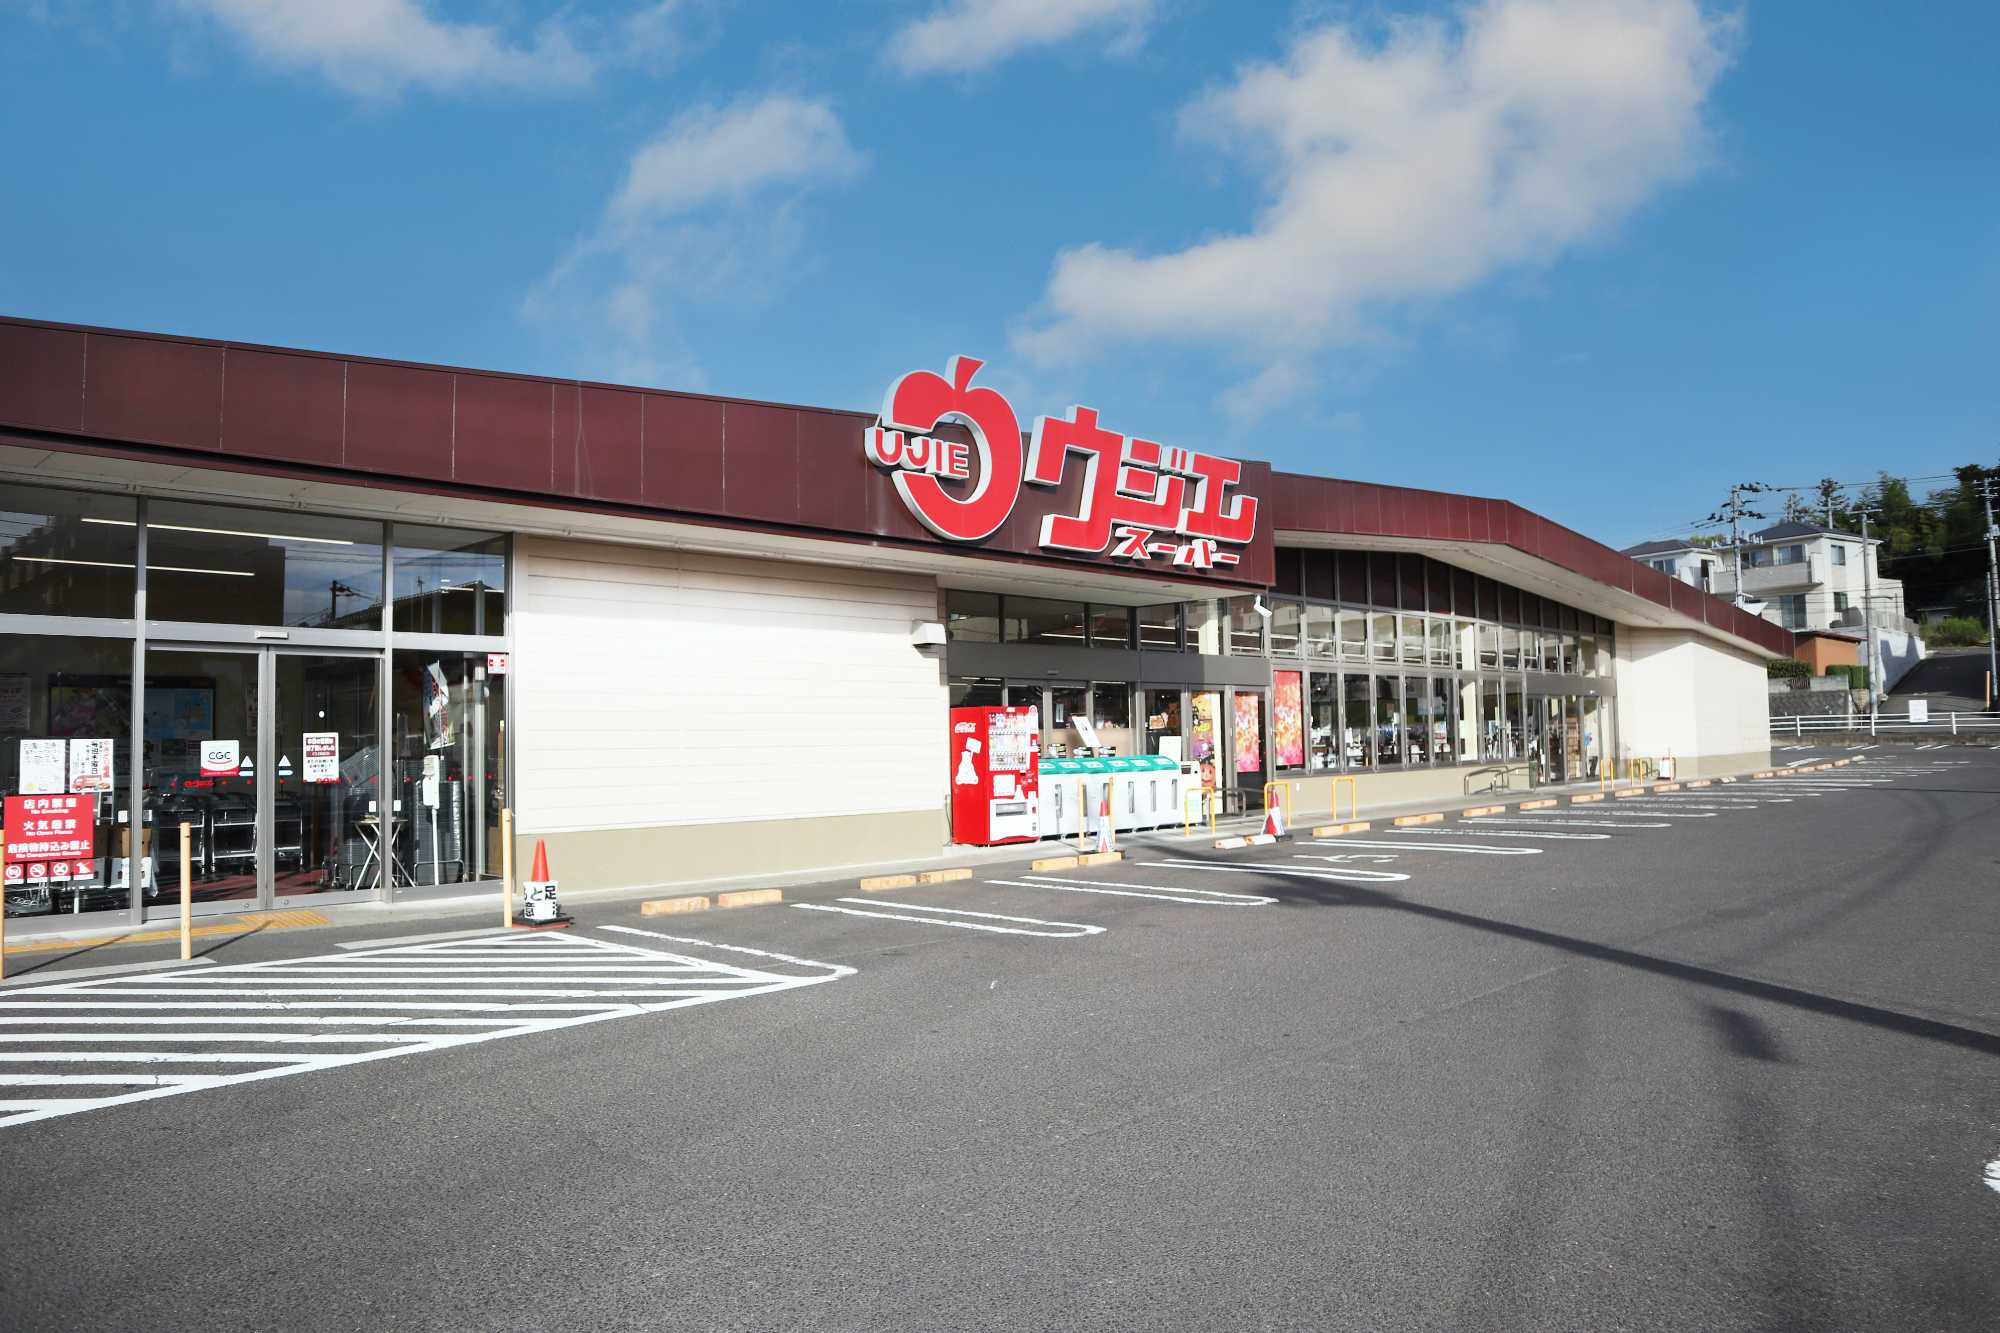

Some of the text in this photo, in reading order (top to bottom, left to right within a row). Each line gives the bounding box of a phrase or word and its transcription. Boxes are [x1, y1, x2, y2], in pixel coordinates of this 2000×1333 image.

[866, 427, 969, 478] UJIE
[1025, 405, 1258, 553] ウジエ
[1110, 527, 1240, 568] スーパー
[208, 751, 231, 760] CGC
